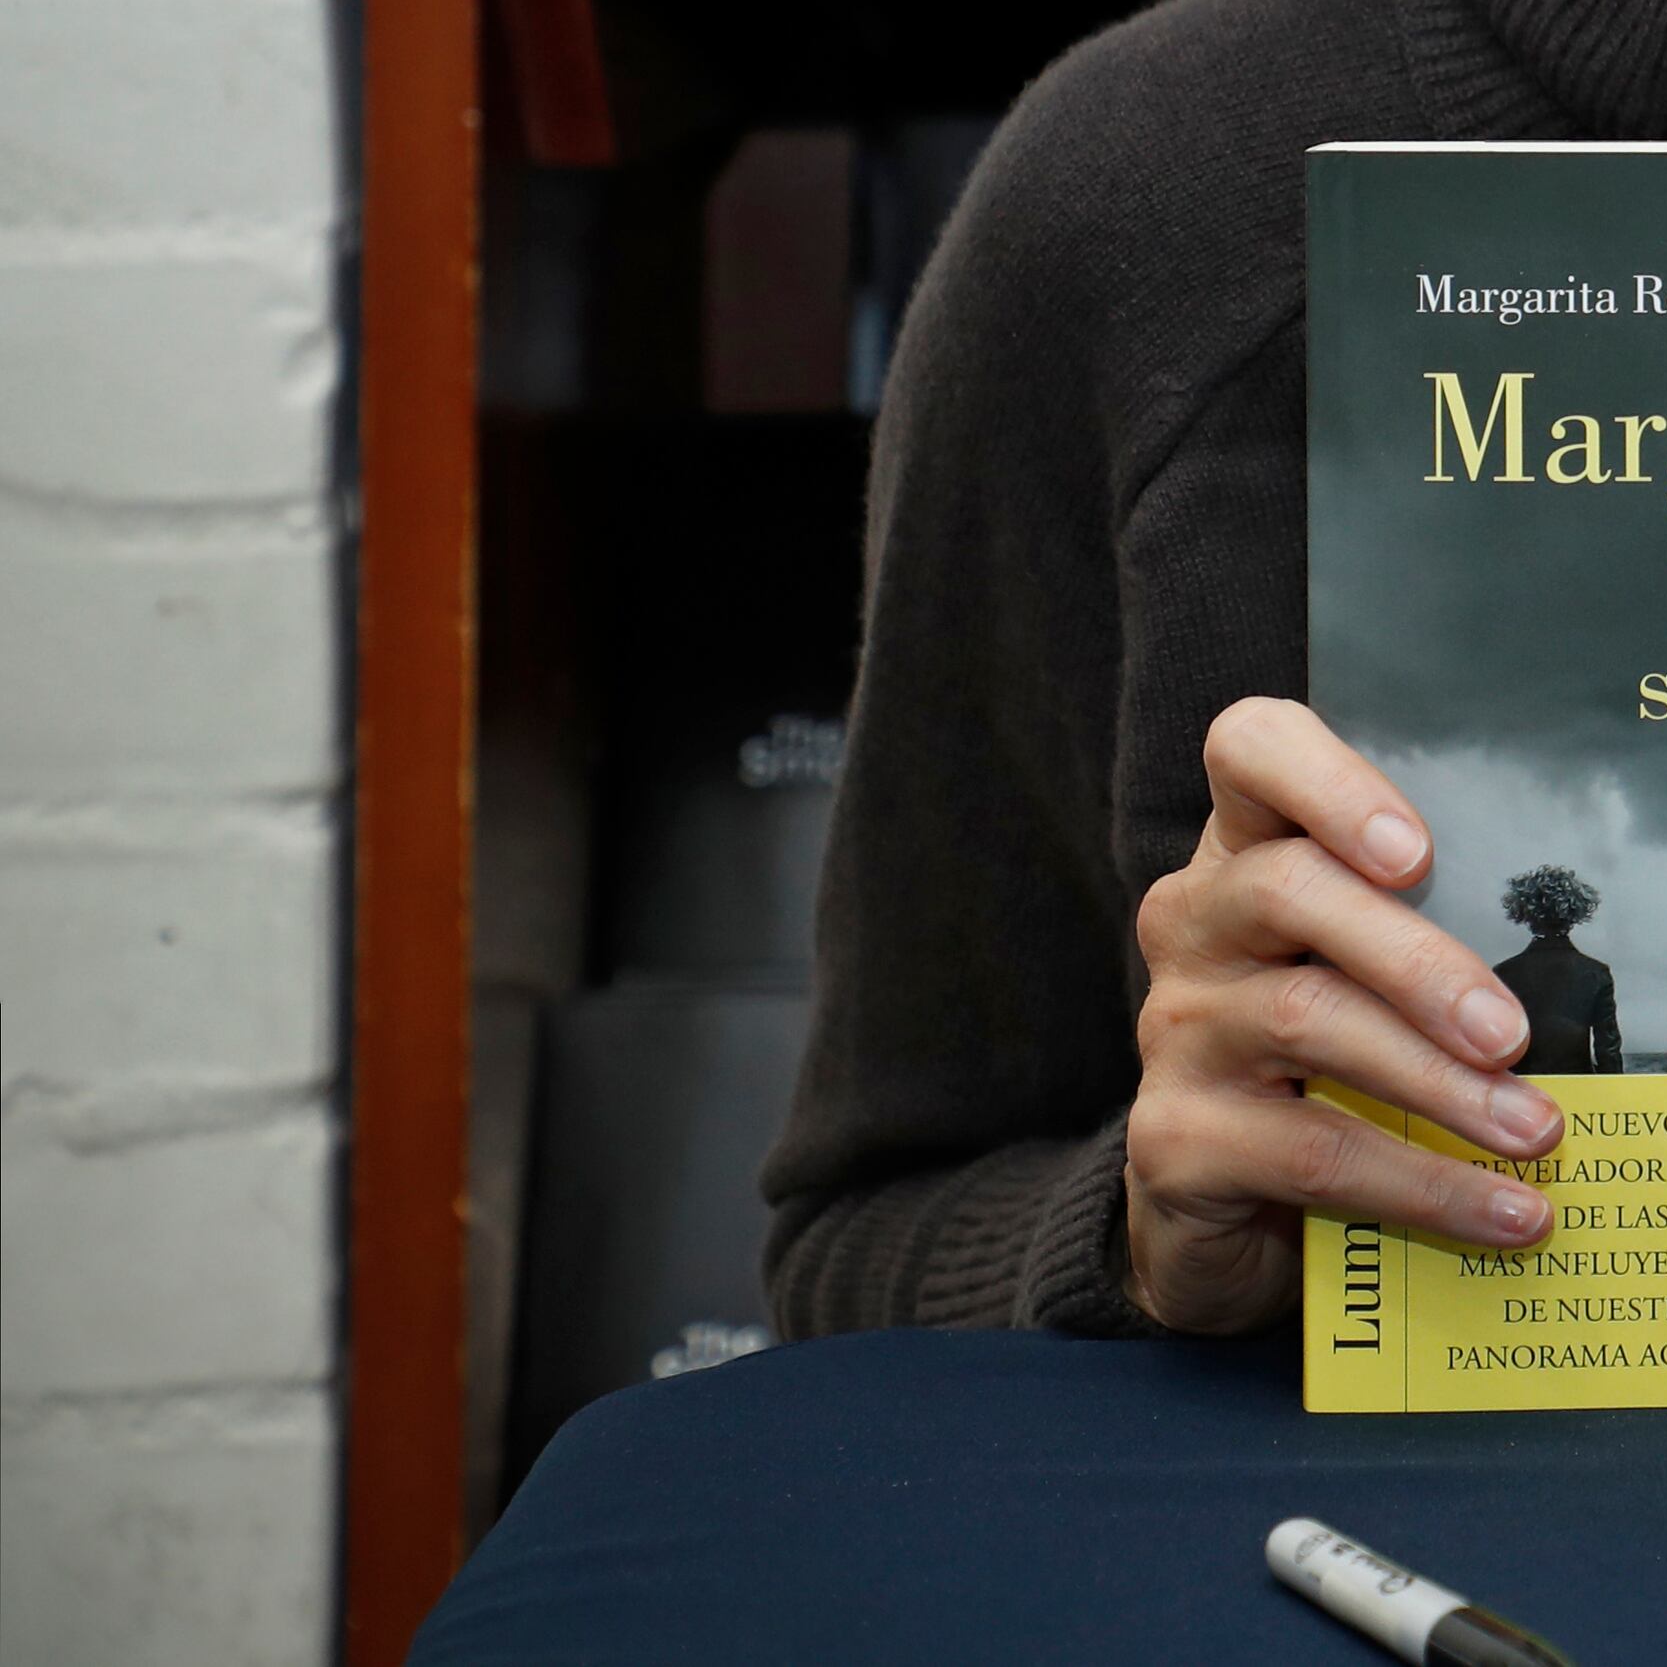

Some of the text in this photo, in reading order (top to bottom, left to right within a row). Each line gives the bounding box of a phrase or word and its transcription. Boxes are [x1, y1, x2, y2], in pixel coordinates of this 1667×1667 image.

[1415, 273, 1619, 326] Margarita
[1562, 1204, 1607, 1231] DE
[1458, 1247, 1525, 1278] MÁS
[1333, 1221, 1380, 1354] Lum
[1503, 1298, 1548, 1324] DE
[1447, 1343, 1630, 1371] PANORAMA
